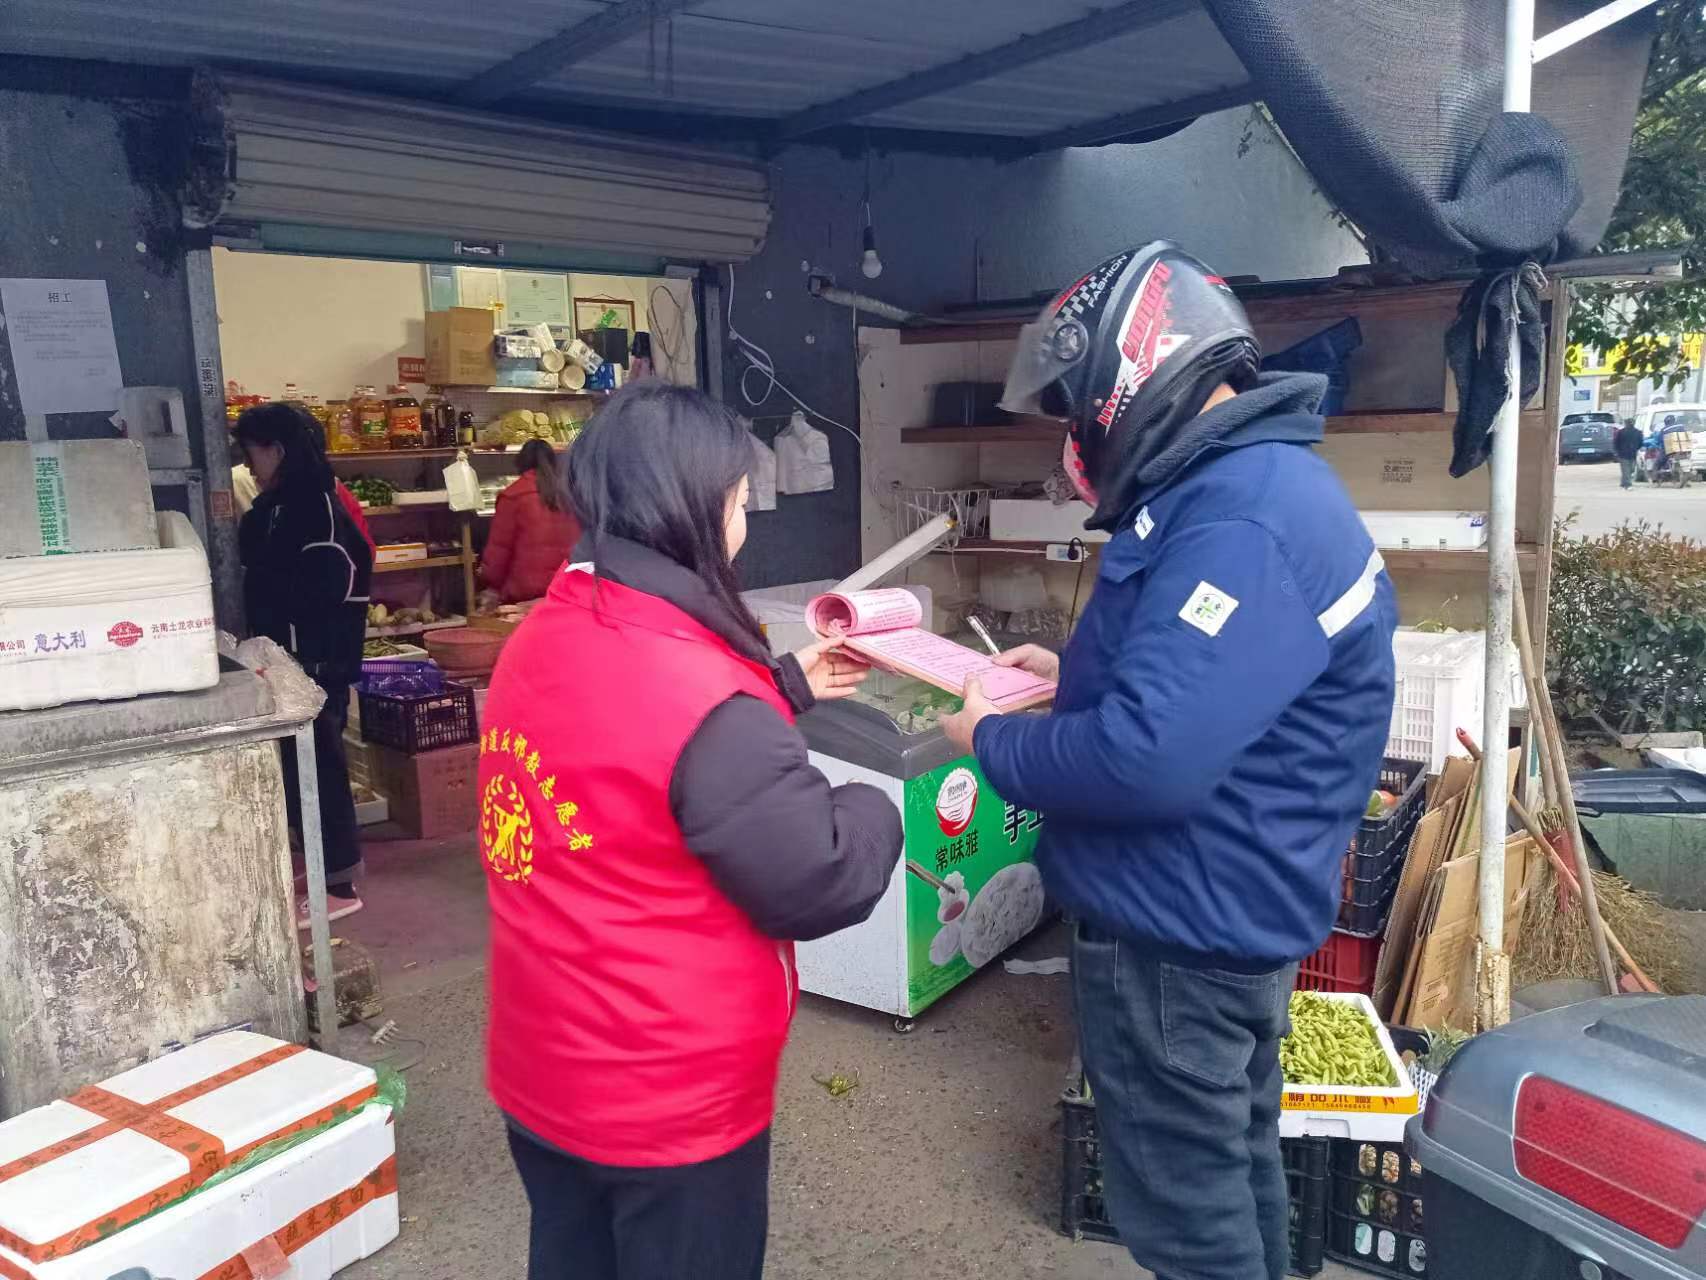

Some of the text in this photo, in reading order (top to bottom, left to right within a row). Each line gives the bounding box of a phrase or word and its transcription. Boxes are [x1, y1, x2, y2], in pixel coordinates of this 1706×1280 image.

[48, 291, 73, 303] 招工
[1088, 255, 1128, 308] FASHION
[34, 630, 87, 653] 意大利
[935, 829, 979, 873] 常味雅
